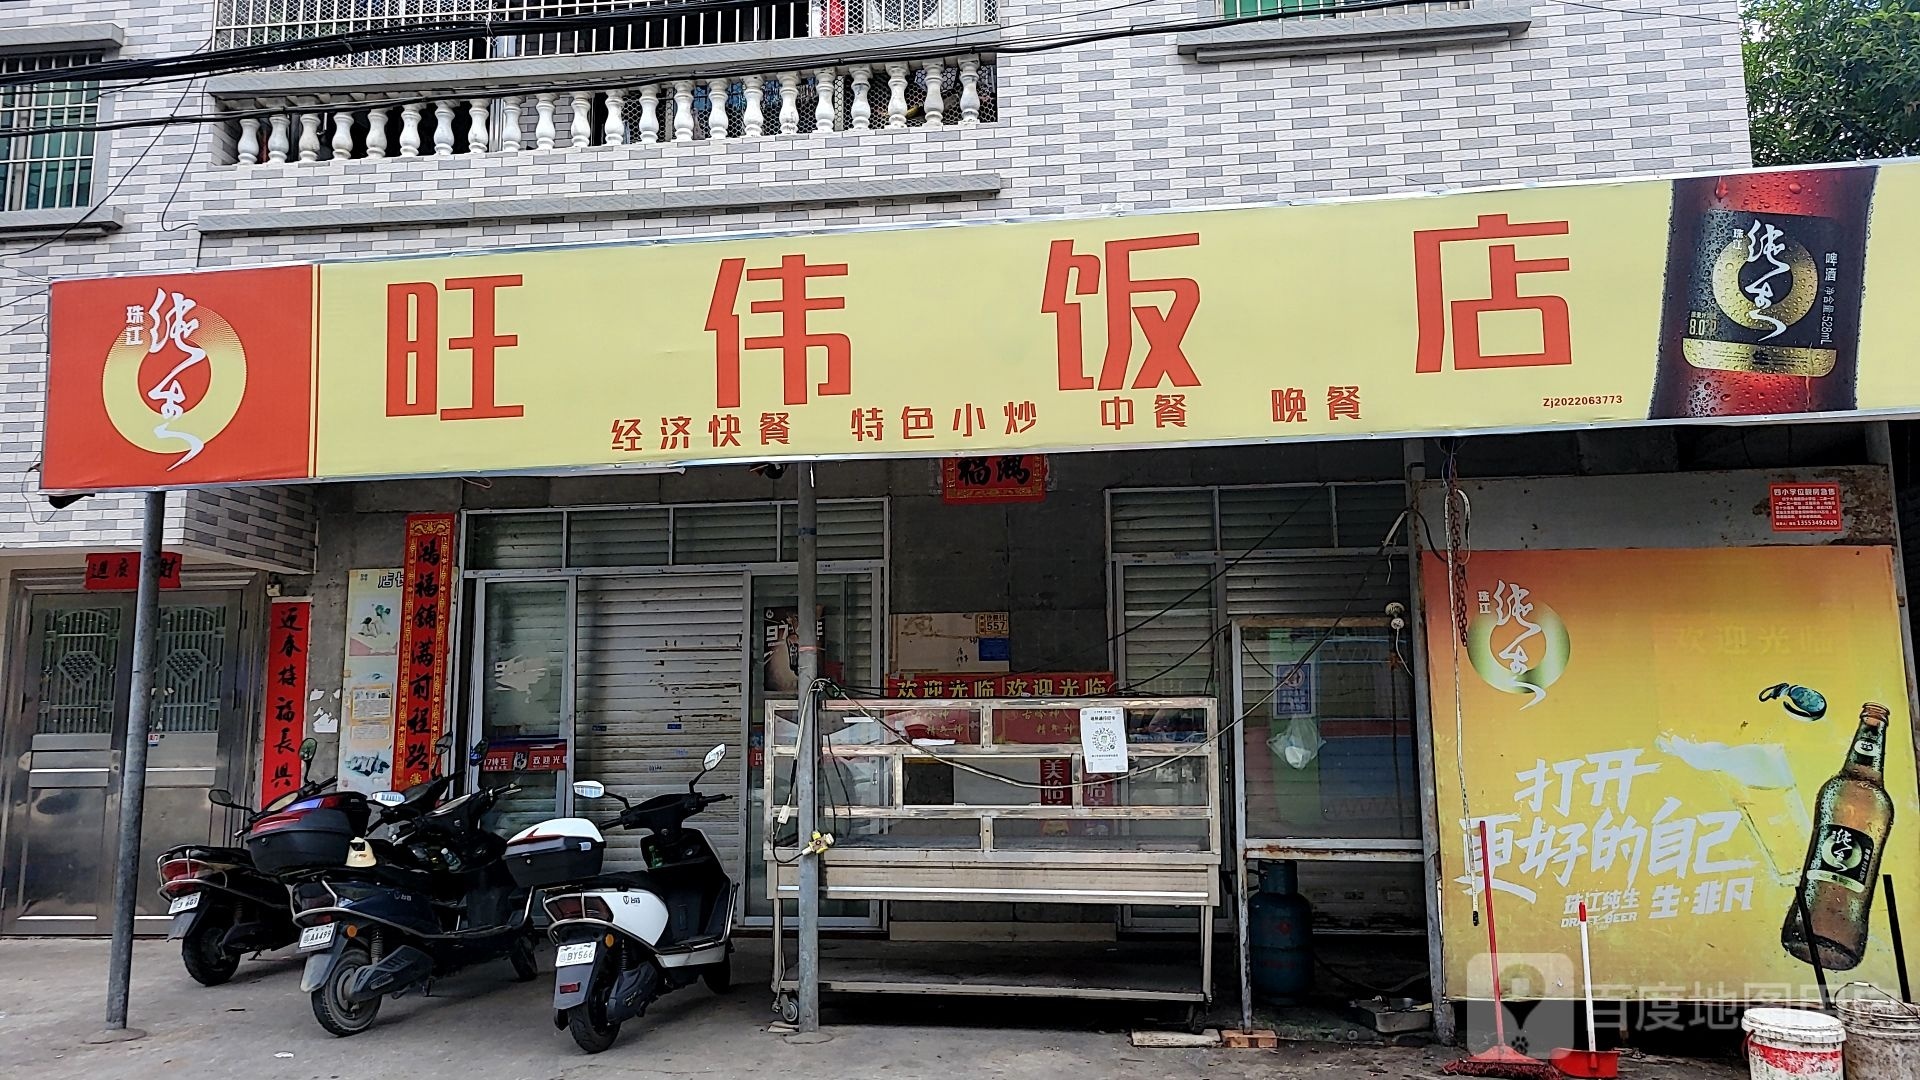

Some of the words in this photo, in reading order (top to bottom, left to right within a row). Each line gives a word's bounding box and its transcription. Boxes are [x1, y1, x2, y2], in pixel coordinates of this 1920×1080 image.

[1733, 227, 1744, 250] 珠江
[1824, 252, 1838, 281] 啤酒
[125, 304, 145, 346] 珠江
[385, 213, 1572, 421] 旺伟饭店
[1543, 395, 1624, 409] Zj2022063773
[610, 412, 792, 451] 经济快餐
[850, 400, 1037, 440] 特色小炒
[1100, 394, 1188, 431] 中餐
[1271, 385, 1362, 423] 晚餐
[987, 621, 1006, 631] 557
[896, 679, 995, 698] 欢迎光临
[1005, 677, 1108, 698] 欢迎光临
[1513, 748, 1663, 817] 打开
[1453, 796, 1760, 904] 更好的自己
[1563, 888, 1641, 915] 珠江纯生
[1604, 911, 1637, 924] BEER
[566, 950, 594, 961] BY566
